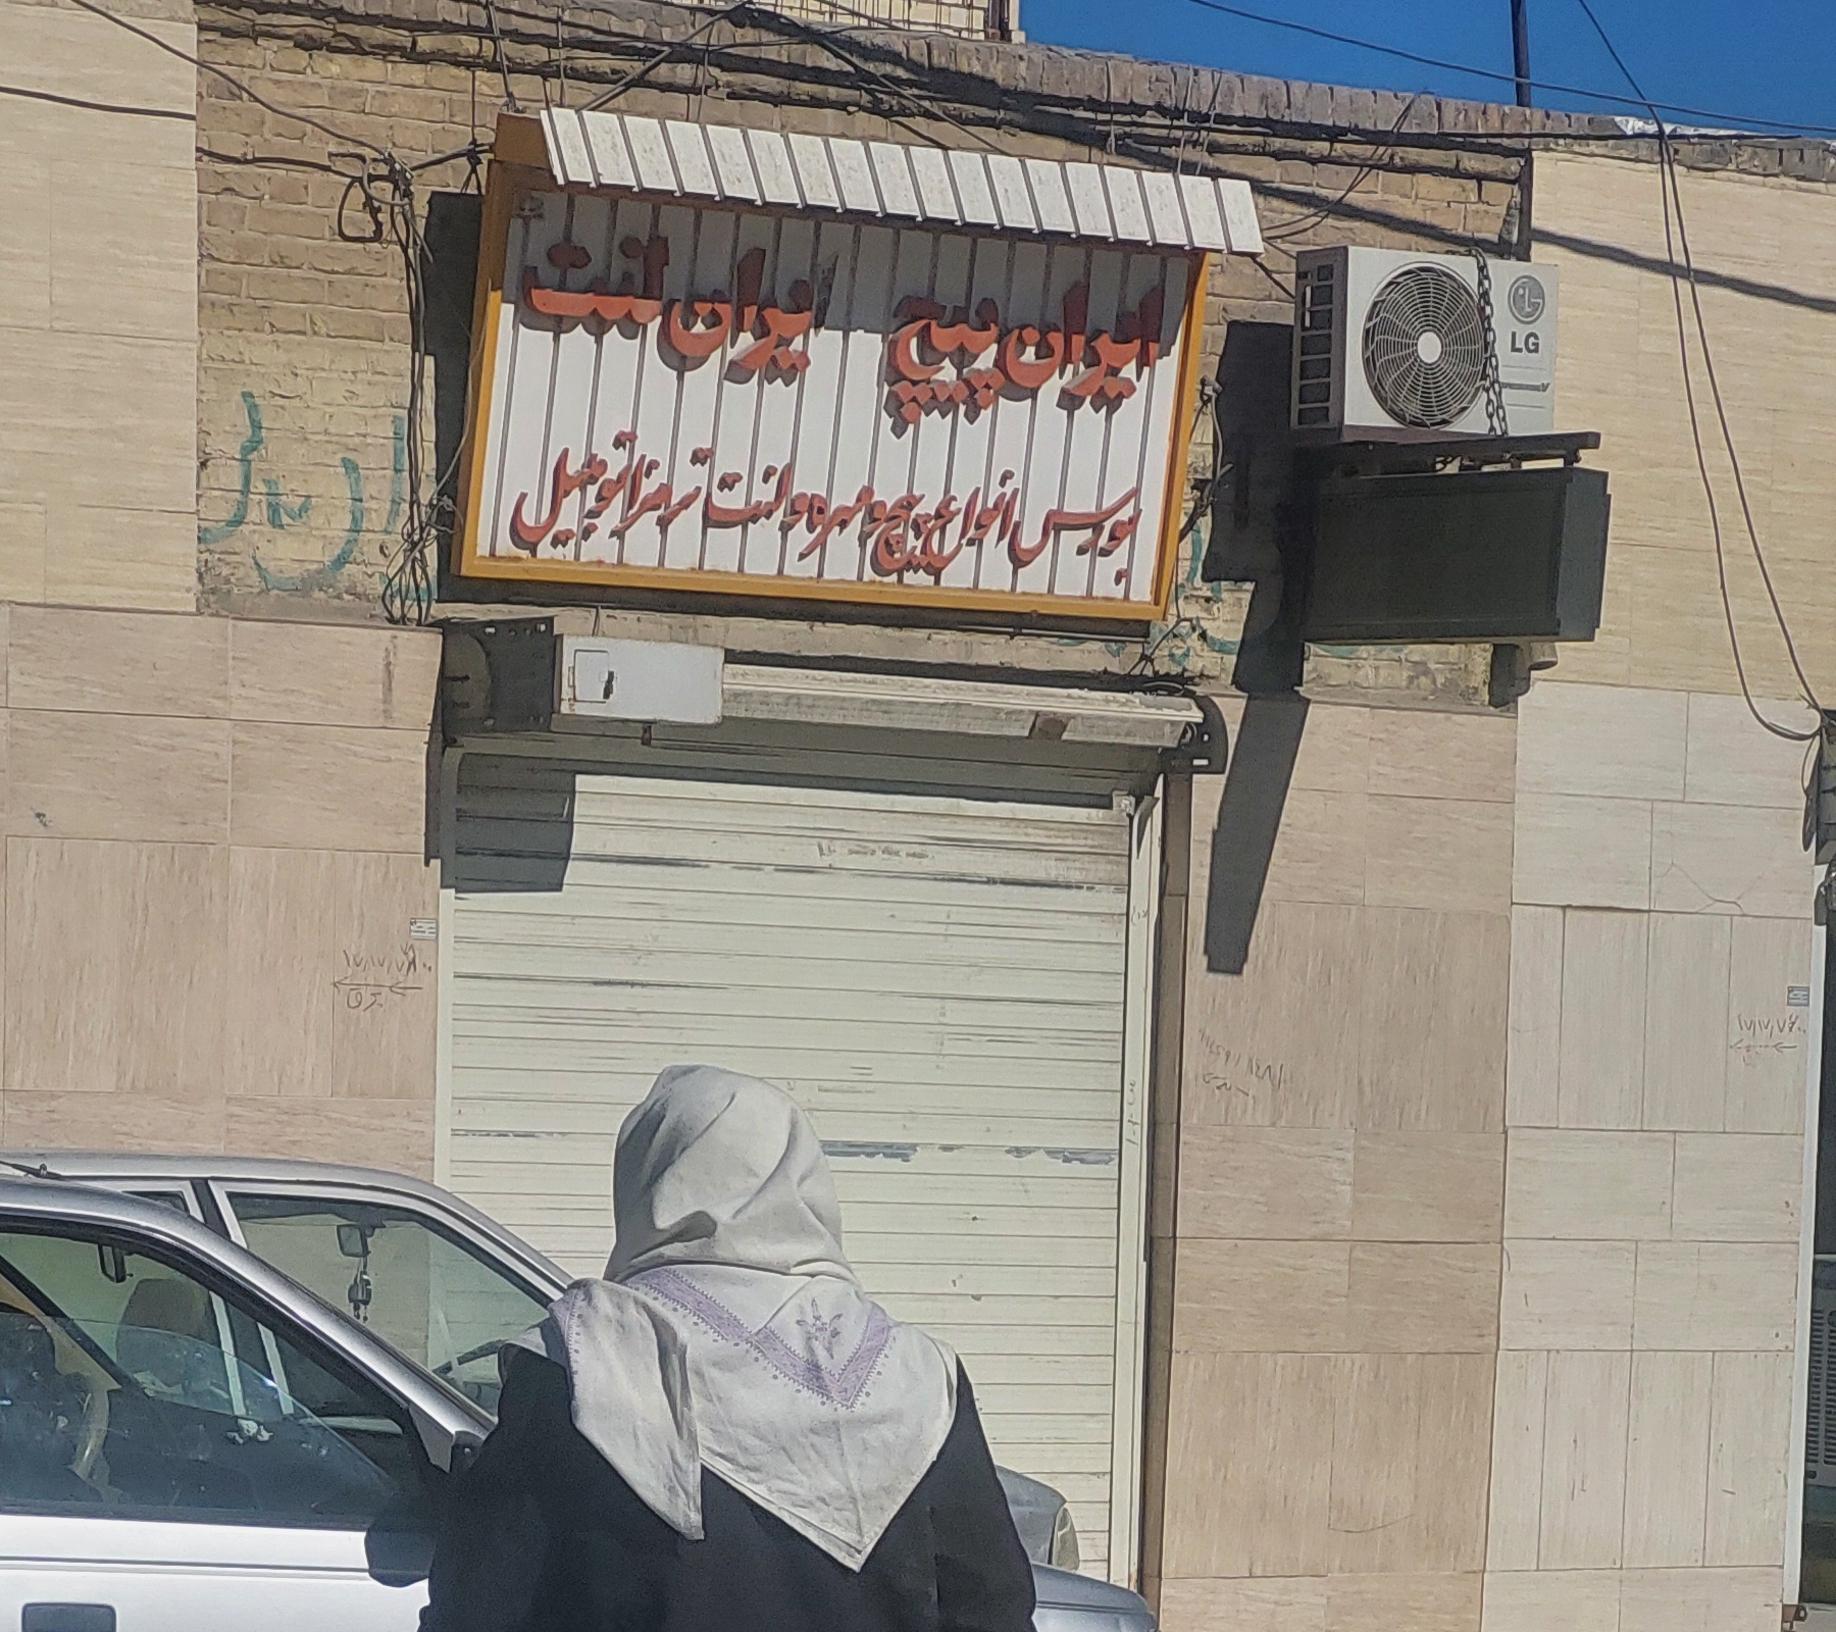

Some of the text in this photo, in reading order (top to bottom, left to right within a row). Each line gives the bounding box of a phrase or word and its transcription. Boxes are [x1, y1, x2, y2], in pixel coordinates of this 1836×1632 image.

[888, 296, 1005, 424] پیچ
[1003, 280, 1163, 398] ایران
[1510, 331, 1540, 354] LG
[509, 430, 648, 551] اتومبیل
[608, 447, 716, 539] ترمز
[702, 462, 792, 530] لنت
[778, 491, 808, 532] و
[797, 485, 875, 562] مهره
[870, 493, 934, 577] پیچ
[920, 469, 1020, 577] انواع
[1008, 486, 1142, 587] بورس
